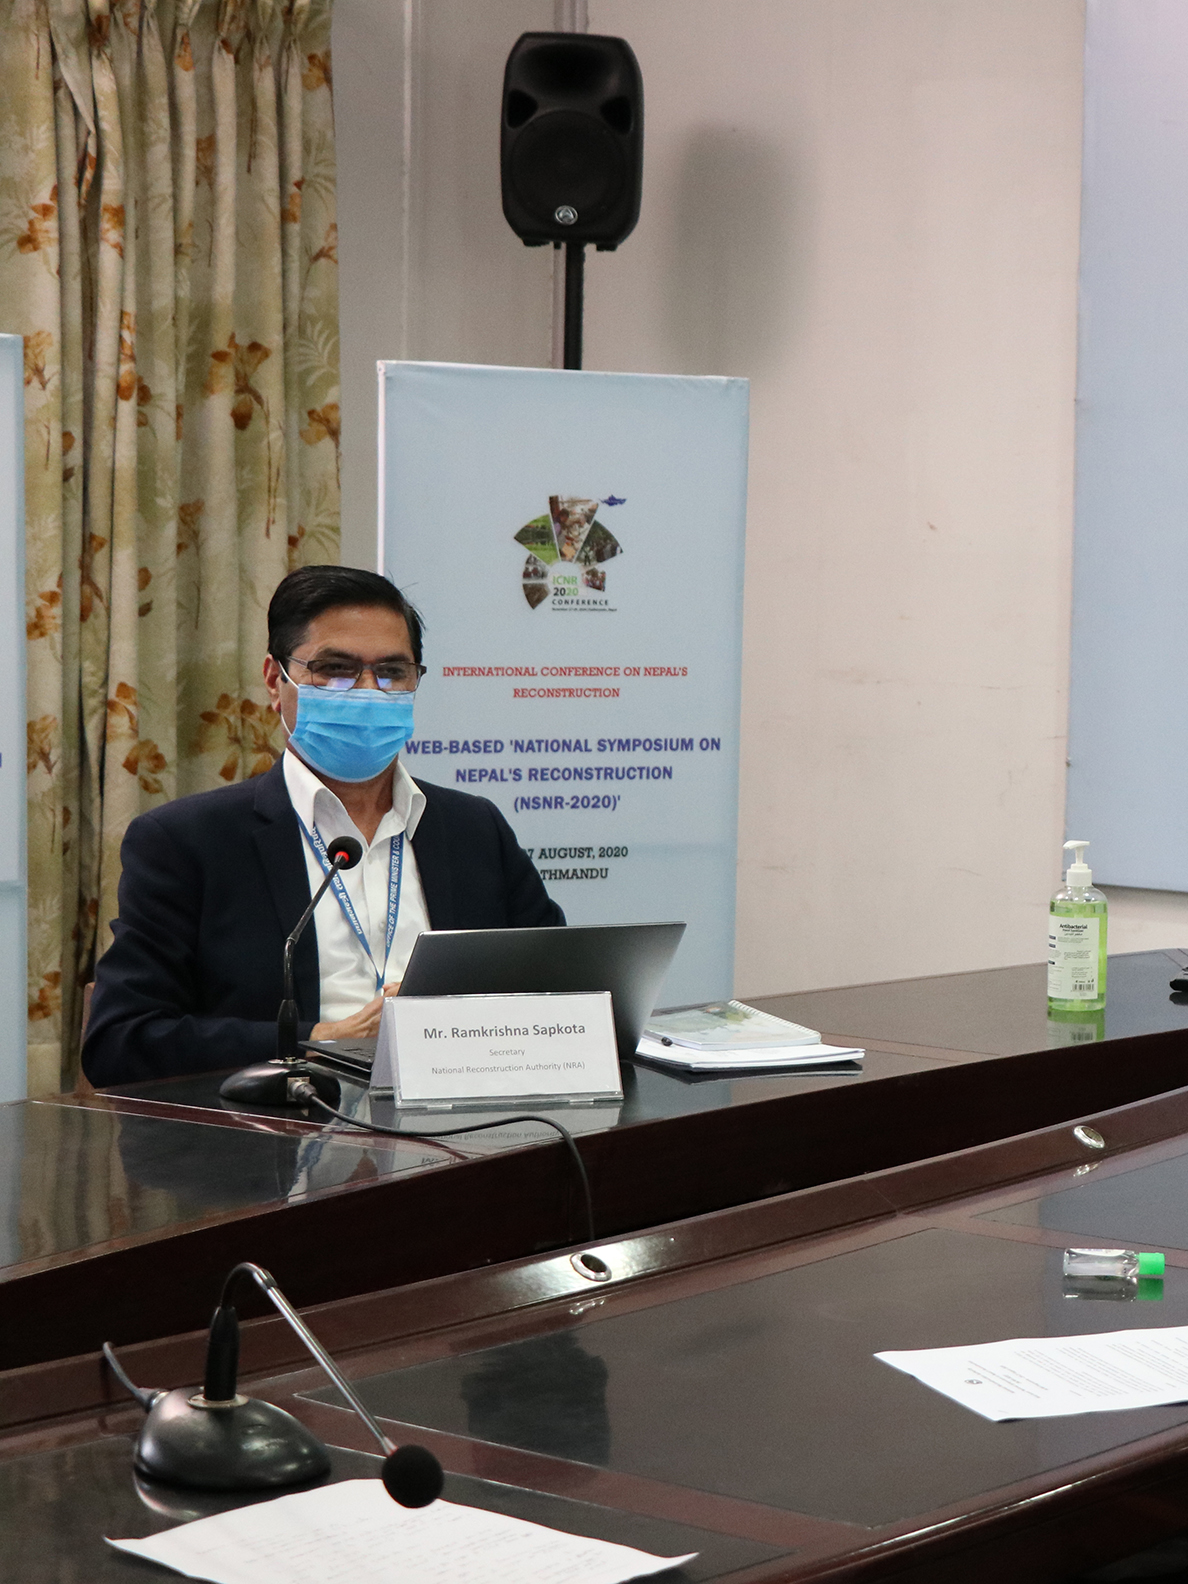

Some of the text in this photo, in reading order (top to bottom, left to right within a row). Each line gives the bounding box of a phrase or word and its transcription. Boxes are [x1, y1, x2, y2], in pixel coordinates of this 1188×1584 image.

[552, 575, 578, 585] ICNR
[553, 587, 579, 597] 2020
[442, 666, 689, 677] INTERNATIONAL CONFERENCE ON NEPAL'S
[512, 688, 620, 698] RECONSTRUCTION
[405, 737, 721, 754] WEB-BASED 'NATIONAL SYMPOSIUM ON
[455, 766, 673, 783] NEPAL'S RECONSTRUCTION
[538, 847, 595, 860] AUGUST,
[598, 846, 628, 858] 2020
[391, 854, 400, 883] MINISTER
[390, 882, 398, 903] PRIME
[389, 902, 397, 915] THE
[424, 1023, 586, 1039] Mr. Ramkrishna Sapkota
[489, 1048, 525, 1057] Secretary
[431, 1060, 585, 1075] National Reconstruction Authority (NRA)
